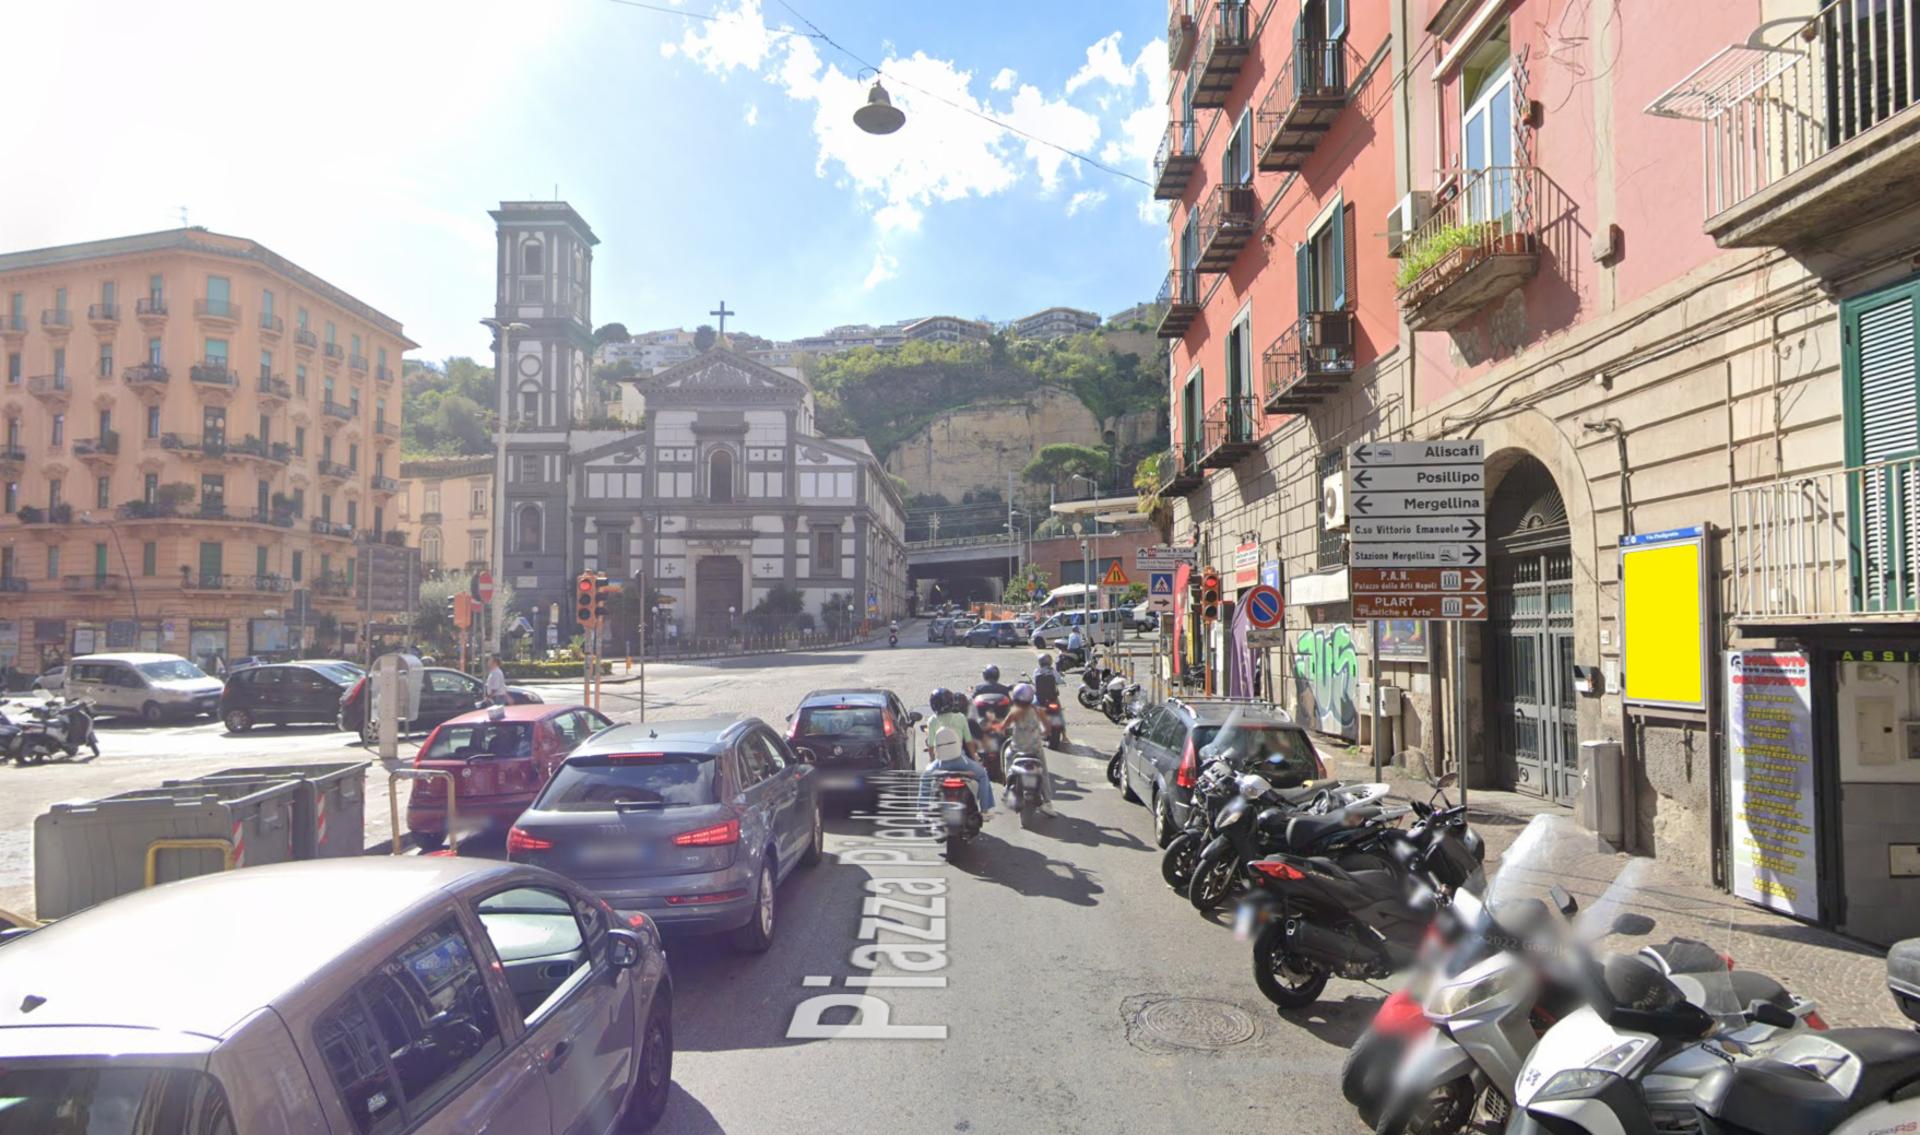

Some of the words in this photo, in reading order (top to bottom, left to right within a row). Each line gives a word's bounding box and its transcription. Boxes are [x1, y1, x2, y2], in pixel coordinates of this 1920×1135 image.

[1425, 445, 1480, 458] Aliscafi
[1417, 472, 1480, 484] Posillipo
[1404, 498, 1480, 511] Mergellina
[1355, 525, 1372, 534] C.so
[1377, 525, 1411, 534] Vittorio
[1416, 524, 1459, 534] Emanuele
[1355, 552, 1388, 560] Stazione
[1393, 551, 1435, 562] Mergellina
[1380, 571, 1410, 580] P.A.N.
[1354, 582, 1379, 590] Palazzo
[1416, 581, 1437, 590] Napoli
[1375, 597, 1415, 607] PLART
[1842, 650, 1920, 662] ASSI
